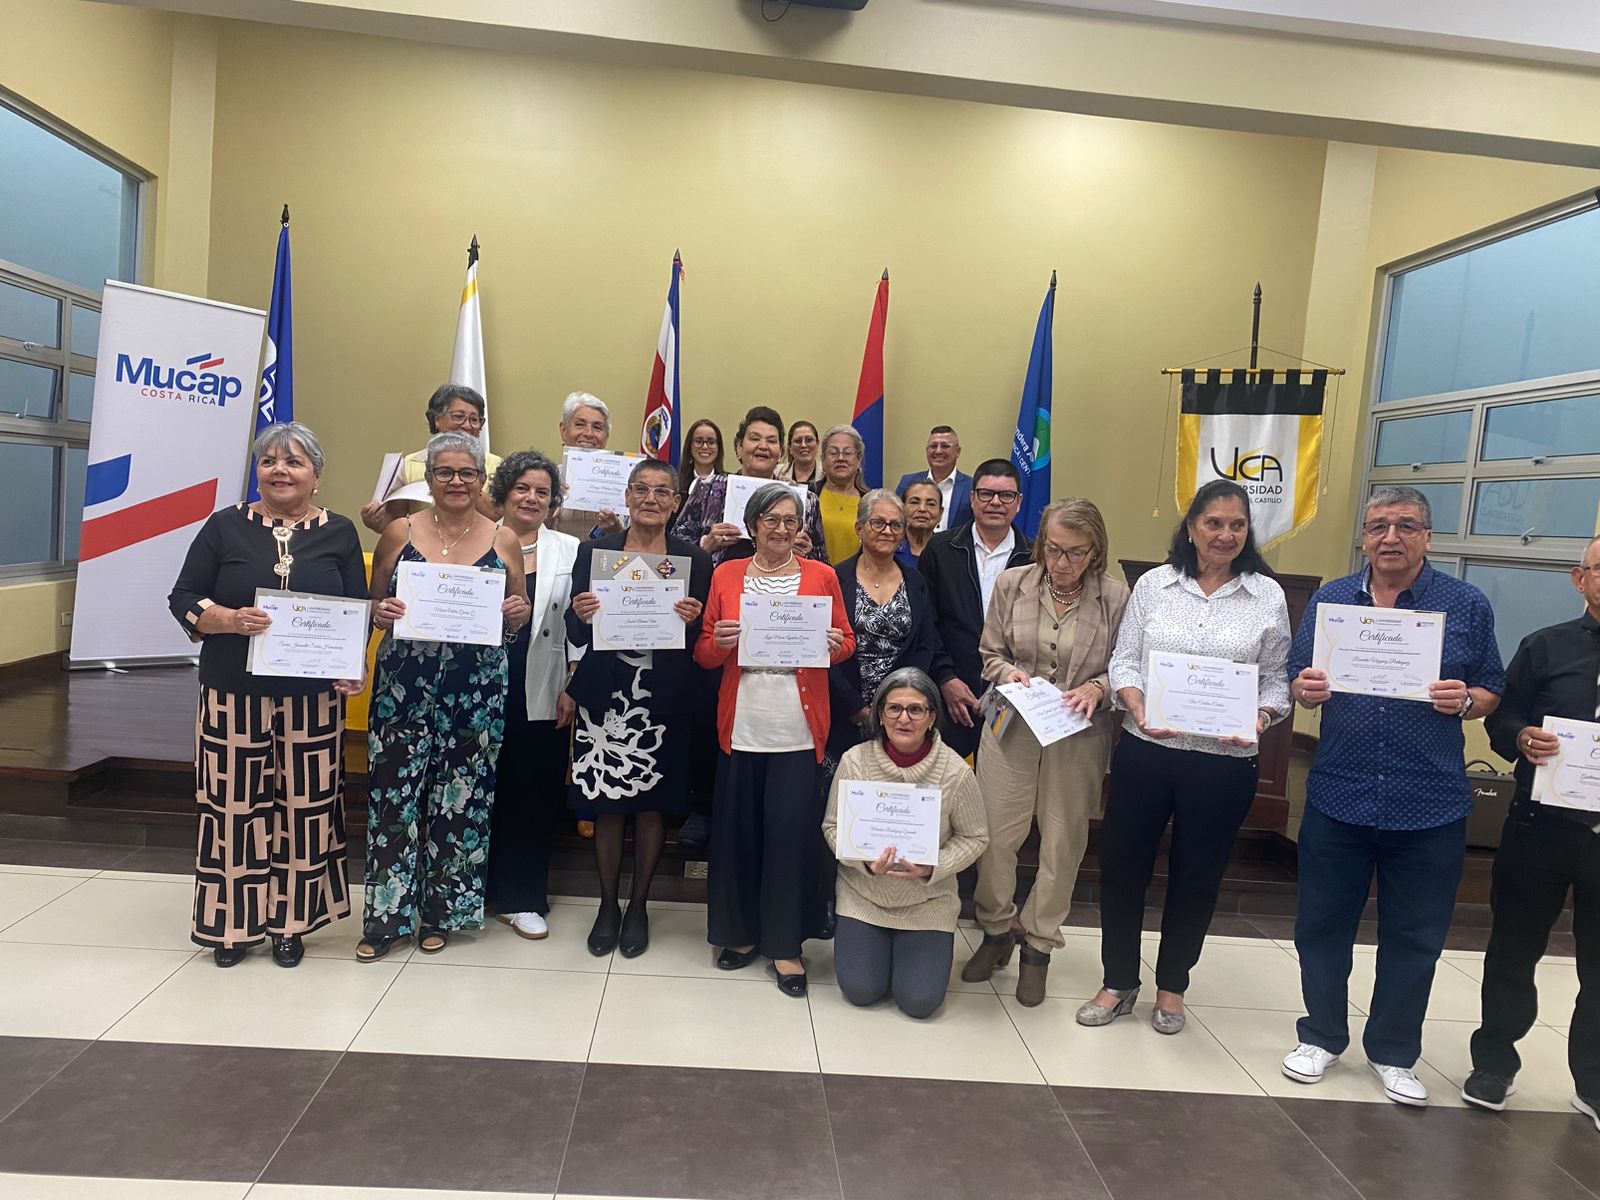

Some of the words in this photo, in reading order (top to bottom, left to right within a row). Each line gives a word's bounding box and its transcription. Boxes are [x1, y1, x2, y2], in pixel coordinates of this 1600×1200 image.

[141, 388, 181, 400] COSTA
[188, 394, 216, 405] RICA
[1210, 447, 1283, 482] UCA
[437, 584, 475, 598] Certificado
[622, 596, 657, 608] Certificado
[292, 616, 332, 631] Certificado
[769, 610, 804, 624] Certificado
[1359, 630, 1403, 645] Certificado
[1186, 674, 1226, 688] Certificado
[1474, 788, 1498, 797] Fender
[876, 802, 912, 816] Certificado
